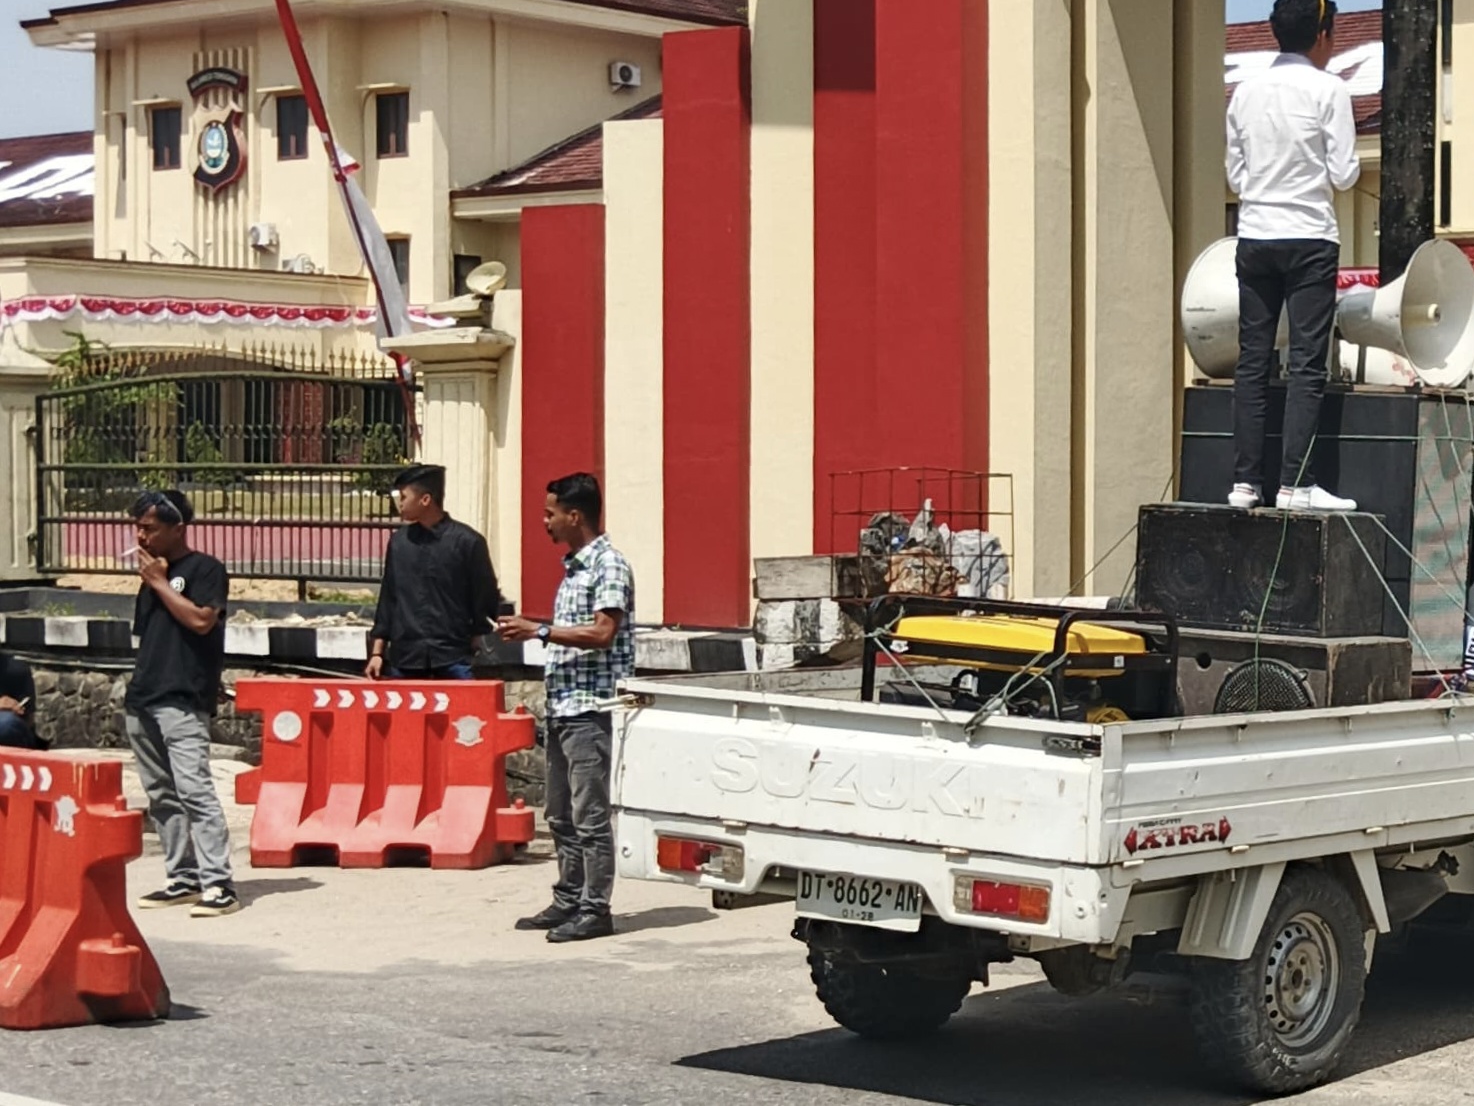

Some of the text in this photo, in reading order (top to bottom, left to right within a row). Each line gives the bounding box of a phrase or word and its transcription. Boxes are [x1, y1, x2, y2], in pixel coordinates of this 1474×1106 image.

[711, 737, 987, 819] SUZUKI
[800, 872, 919, 913] DT 8662 AN
